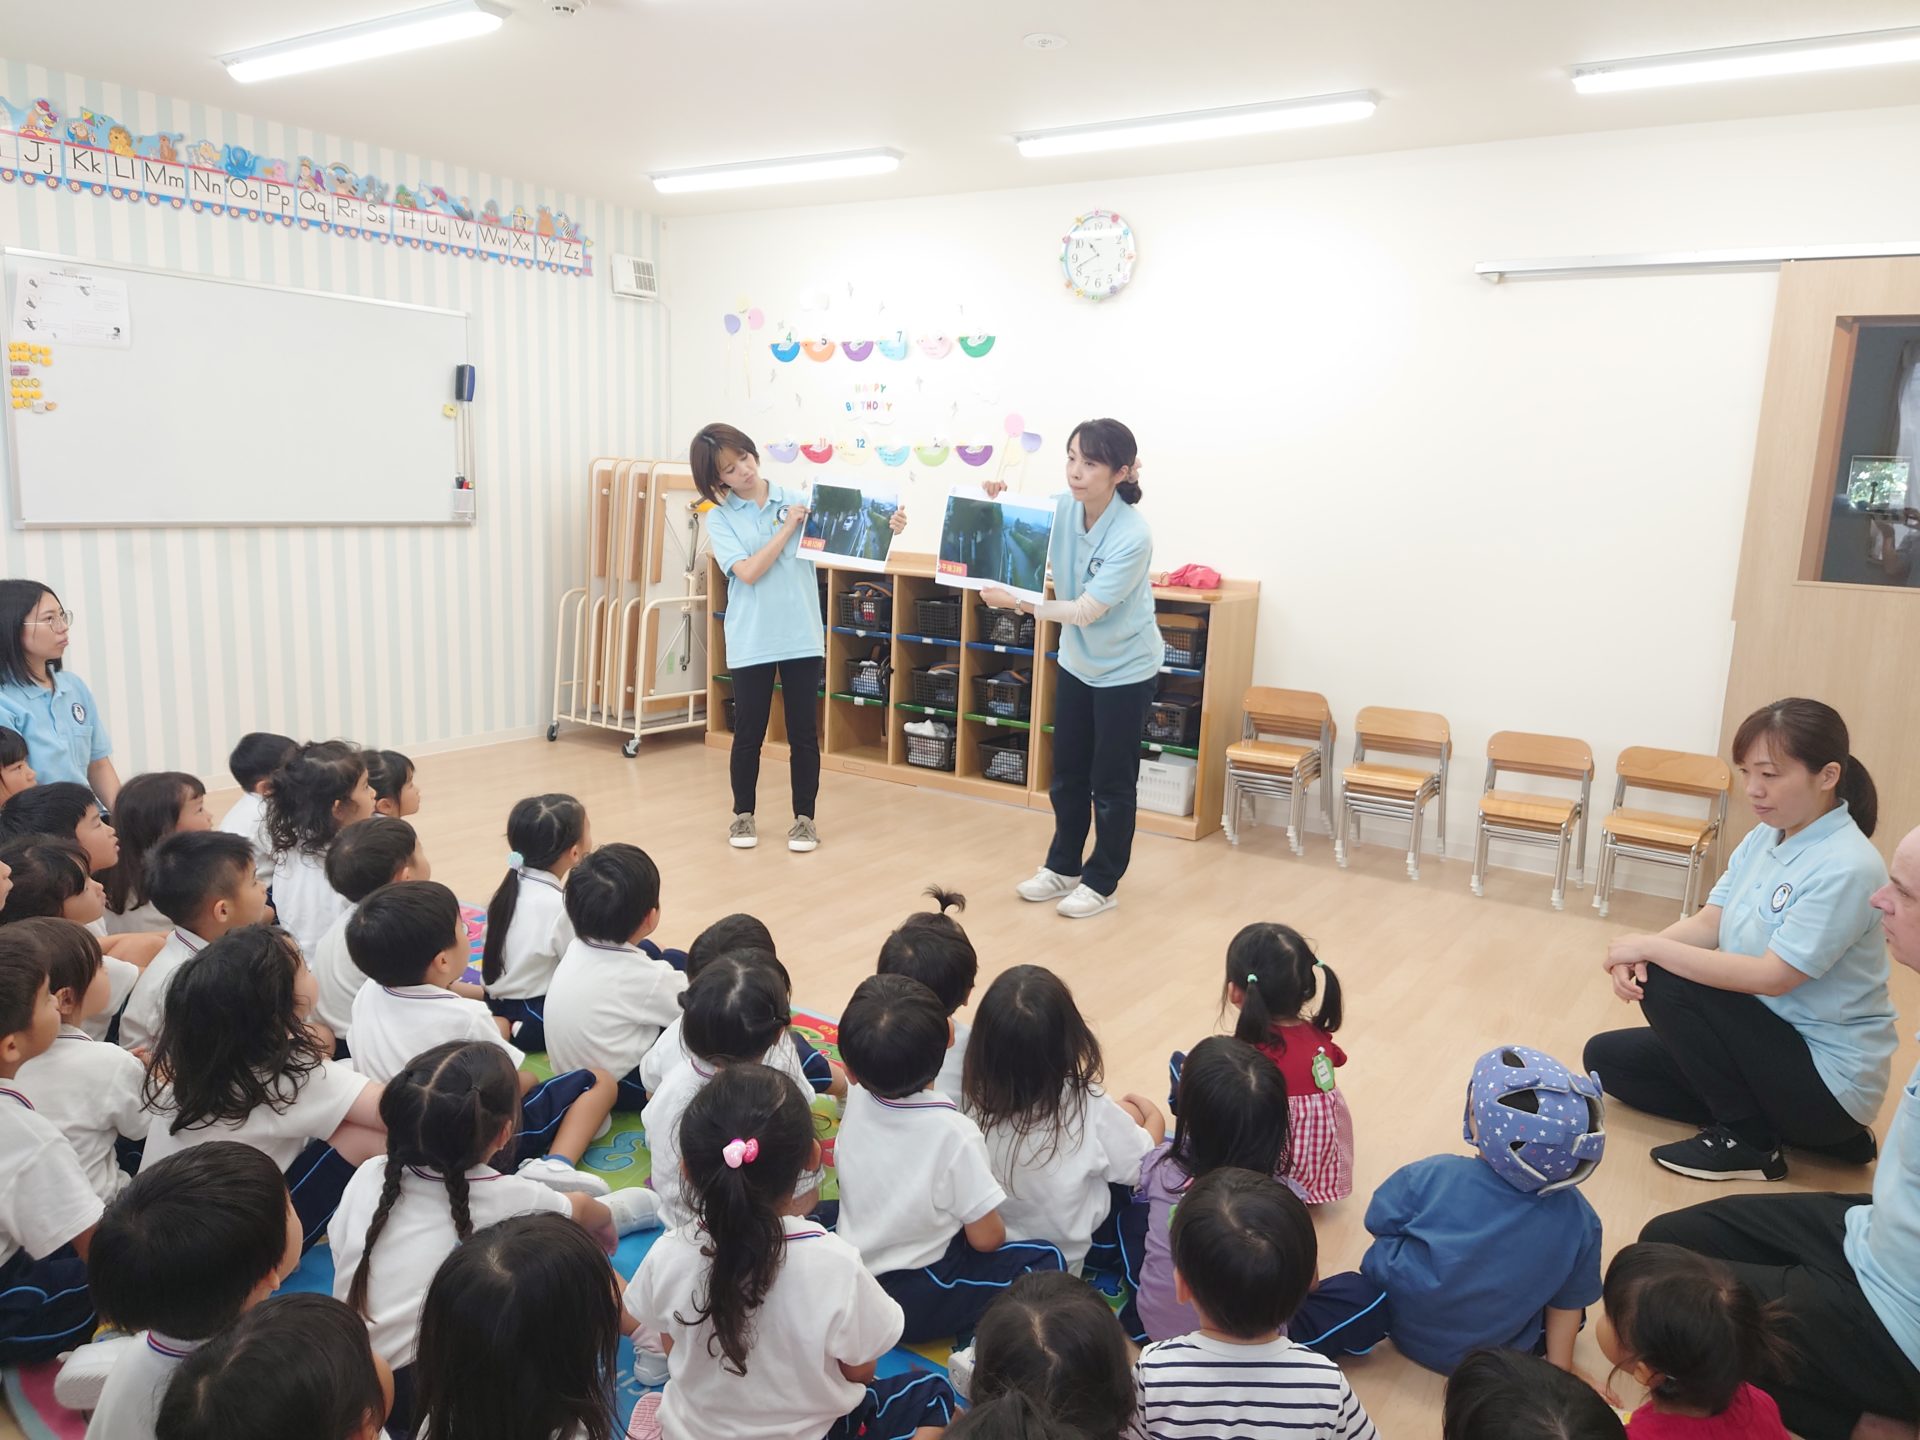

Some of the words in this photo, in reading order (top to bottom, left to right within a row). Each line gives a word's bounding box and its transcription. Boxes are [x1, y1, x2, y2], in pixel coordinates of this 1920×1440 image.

[24, 140, 53, 175] Jj
[72, 148, 102, 175] Kk
[145, 163, 184, 189] Mm
[193, 170, 222, 196] Nn
[229, 177, 258, 201] Oo
[266, 183, 290, 214] Pp
[299, 190, 327, 222] Qq
[336, 197, 358, 219] Rr
[367, 204, 385, 225] Ss
[398, 209, 416, 229] Tt
[426, 215, 447, 236] Uu
[454, 220, 472, 240] Vv
[478, 225, 508, 248] Ww
[512, 232, 530, 252] Xx
[539, 238, 555, 262] Yy
[564, 241, 580, 260] Zz
[1075, 239, 1084, 249] 10
[1119, 248, 1126, 258] 3
[1071, 254, 1079, 264] 9
[1084, 276, 1091, 286] 7
[1094, 278, 1102, 288] 6
[1107, 274, 1113, 284] 5
[786, 332, 793, 344] 4
[896, 331, 903, 343] 7
[855, 383, 887, 393] HAPY
[855, 438, 866, 449] 12
